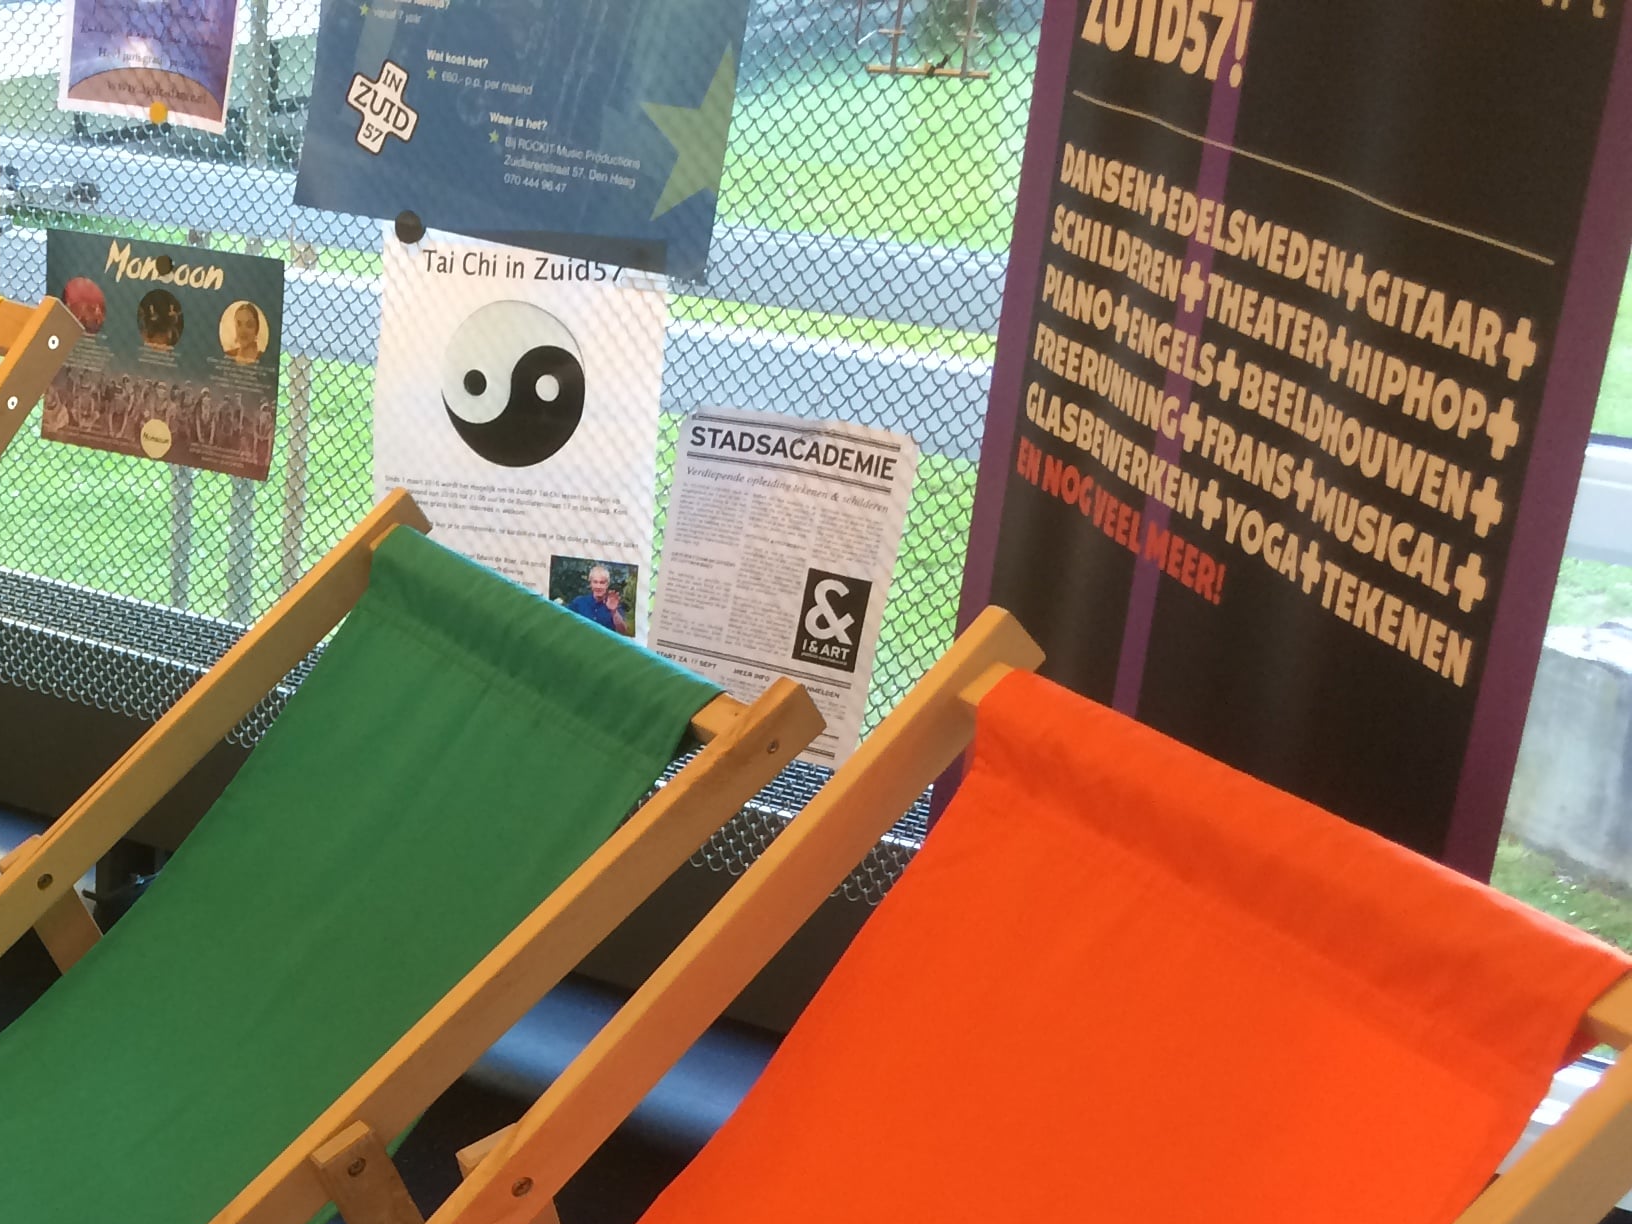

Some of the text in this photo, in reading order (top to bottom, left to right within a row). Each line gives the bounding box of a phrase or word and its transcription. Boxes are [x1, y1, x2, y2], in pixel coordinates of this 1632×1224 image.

[426, 49, 444, 62] Wat
[382, 69, 403, 93] IN
[484, 79, 500, 90] per
[501, 82, 533, 96] maand
[353, 82, 410, 132] ZUID
[362, 123, 383, 143] 57
[505, 136, 517, 150] Bij
[585, 150, 641, 170] Productions
[588, 169, 608, 182] Den
[105, 239, 225, 290] Monoon
[423, 250, 455, 274] Tai
[462, 252, 497, 277] Chi
[505, 255, 525, 279] in
[1060, 141, 1502, 367] DANSEN EDELSMEDEN GITAAR
[1051, 203, 1487, 440] SCHILDEREN THEATER HIPHOP
[1042, 263, 1471, 521] PIANO ENGELS BEELDHOUWEN
[690, 425, 898, 481] STADSACADEMIE
[1033, 321, 1451, 597] FREERUNNING FRANS MUSICAL
[686, 466, 746, 483] Verdiepende
[746, 474, 792, 493] opleiding
[830, 492, 839, 502] &
[1016, 435, 1227, 606] EN NOG VEEL MEER!
[1026, 381, 1472, 688] GLASBEWERKEN YOGA TEKENEN
[801, 638, 809, 651] I
[808, 641, 819, 653] &
[819, 643, 851, 661] ART
